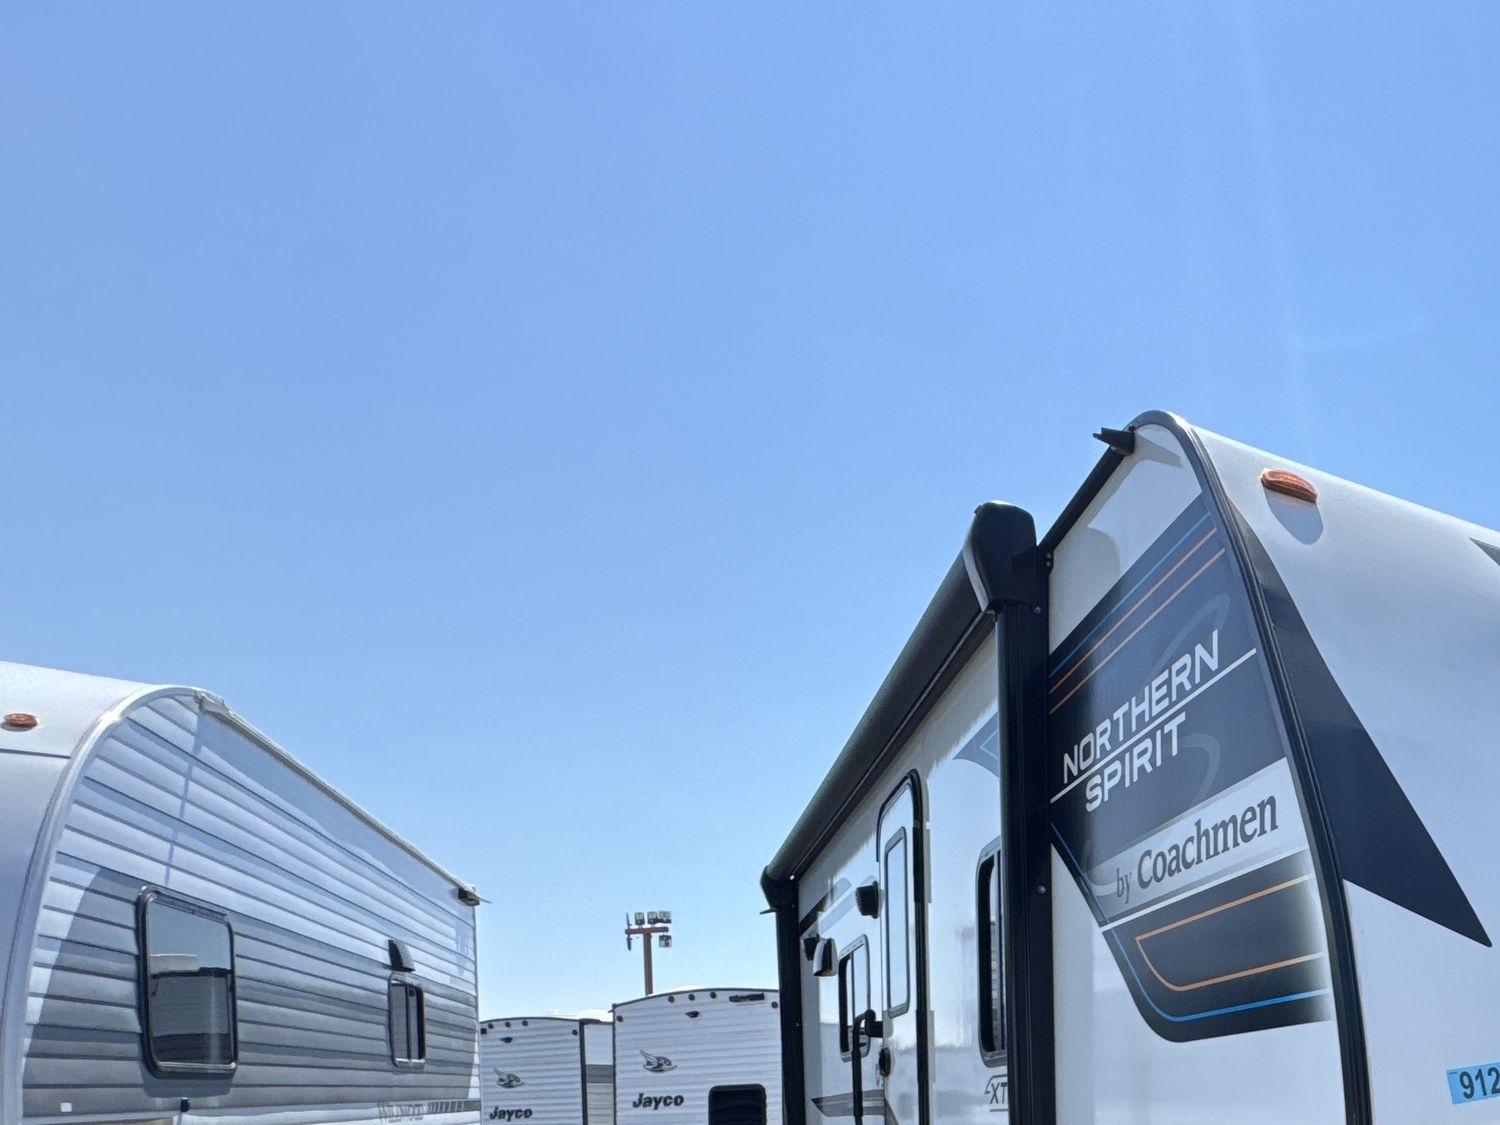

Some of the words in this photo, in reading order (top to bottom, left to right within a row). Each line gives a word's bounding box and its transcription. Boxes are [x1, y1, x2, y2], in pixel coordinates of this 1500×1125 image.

[1063, 628, 1219, 784] NORTHERN
[1085, 711, 1186, 813] SPIRIT
[1116, 867, 1132, 904] by
[1137, 794, 1279, 890] Coachmen
[489, 1105, 533, 1122] Jayco
[632, 1092, 685, 1110] Jayco
[990, 1081, 1008, 1104] XT
